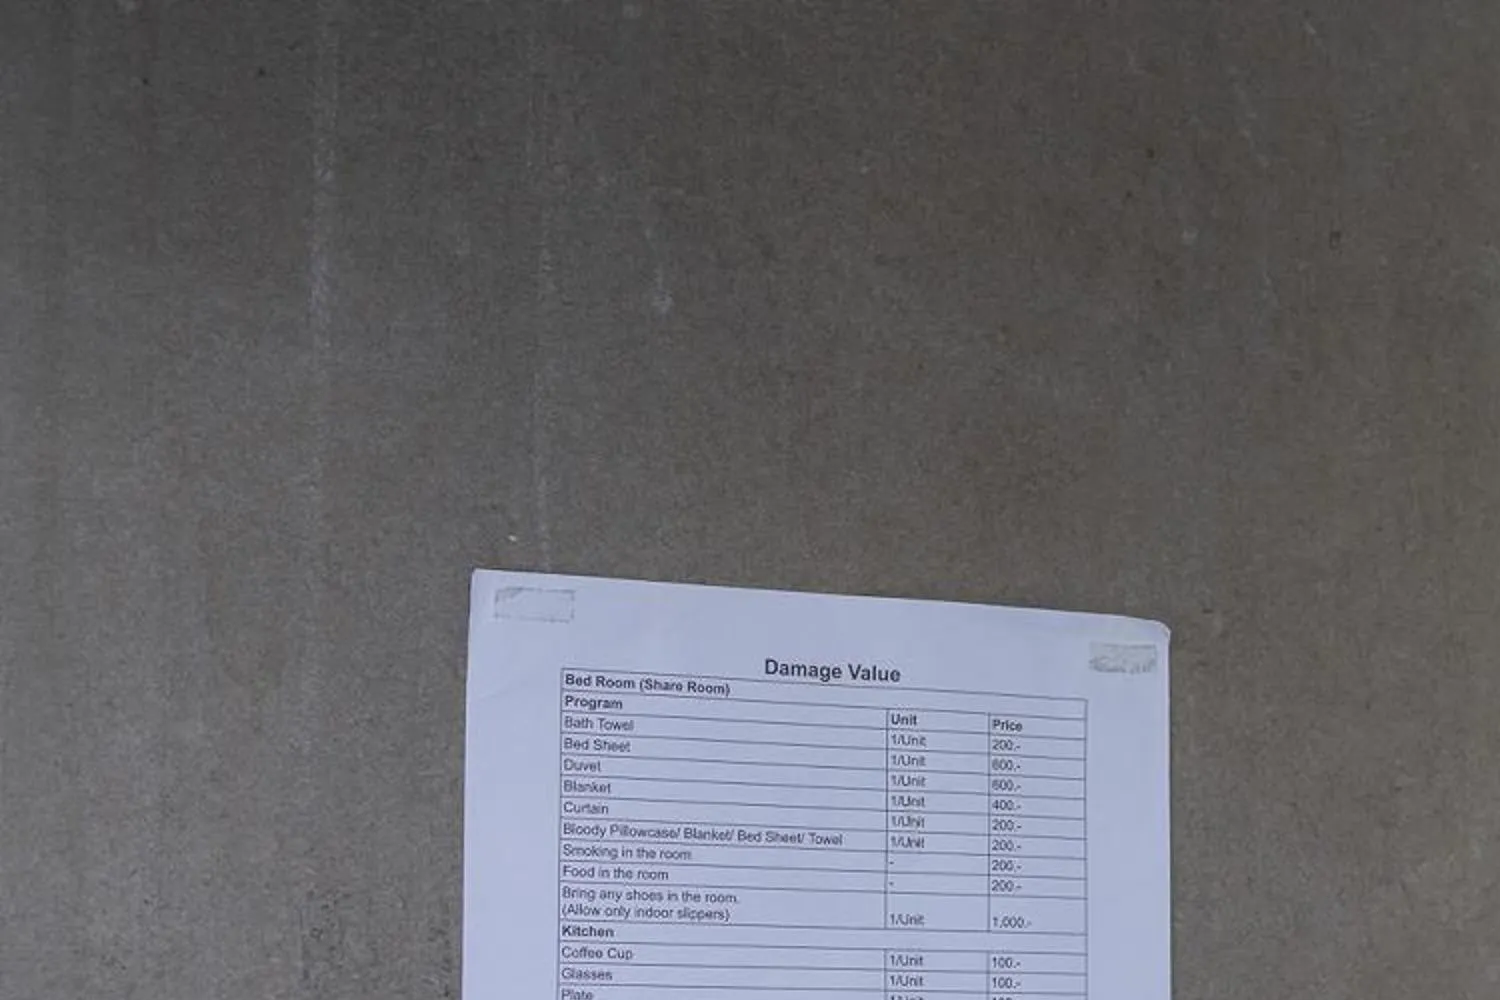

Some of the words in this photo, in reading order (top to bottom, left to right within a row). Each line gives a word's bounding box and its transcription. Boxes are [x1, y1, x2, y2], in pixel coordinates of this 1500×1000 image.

[765, 658, 842, 682] Damage
[849, 664, 901, 682] Value
[565, 674, 592, 687] Bed
[595, 676, 635, 689] Room
[639, 678, 684, 694] (Share
[687, 683, 730, 697] Room)
[564, 695, 623, 711] Program
[564, 716, 594, 730] Bath
[598, 717, 634, 731] Towel
[890, 713, 917, 726] Unit
[993, 719, 1023, 732] Price
[564, 738, 589, 750] Bed
[594, 739, 630, 752] Sheet
[891, 734, 926, 747] 1/Unit
[563, 759, 601, 772] Duvet
[891, 754, 926, 767] 1/Unit
[563, 780, 611, 794] Blanket
[891, 775, 926, 787] 1/Unit
[563, 801, 609, 815] Curtain
[891, 796, 925, 808] 1/Unit
[891, 816, 925, 829] 1/Unit
[563, 823, 606, 837] Bloody
[738, 830, 762, 842] Bed
[809, 832, 843, 845] Towel
[891, 836, 925, 848] 1/Unit
[563, 844, 618, 860] Smoking
[622, 846, 633, 859] in
[636, 845, 656, 859] the
[659, 849, 692, 861] room
[562, 866, 595, 879] Food
[599, 867, 610, 880] in
[613, 867, 633, 880] the
[636, 869, 669, 881] room
[562, 887, 596, 901] Bring
[600, 890, 622, 903] any
[626, 889, 664, 902] shoes
[667, 890, 677, 902] in
[681, 890, 701, 903] the
[562, 905, 601, 919] (Allow
[604, 906, 631, 920] only
[635, 907, 674, 919] indoor
[677, 908, 730, 922] slippers)
[890, 914, 924, 926] 1/Unit
[561, 926, 615, 939] Kitchen
[561, 946, 603, 959] Coffee
[607, 948, 633, 961] Cup
[890, 955, 924, 966] 1/Unit
[561, 967, 613, 981] Glasses
[890, 975, 924, 987] 1/Unit
[561, 989, 594, 1000] Plate
